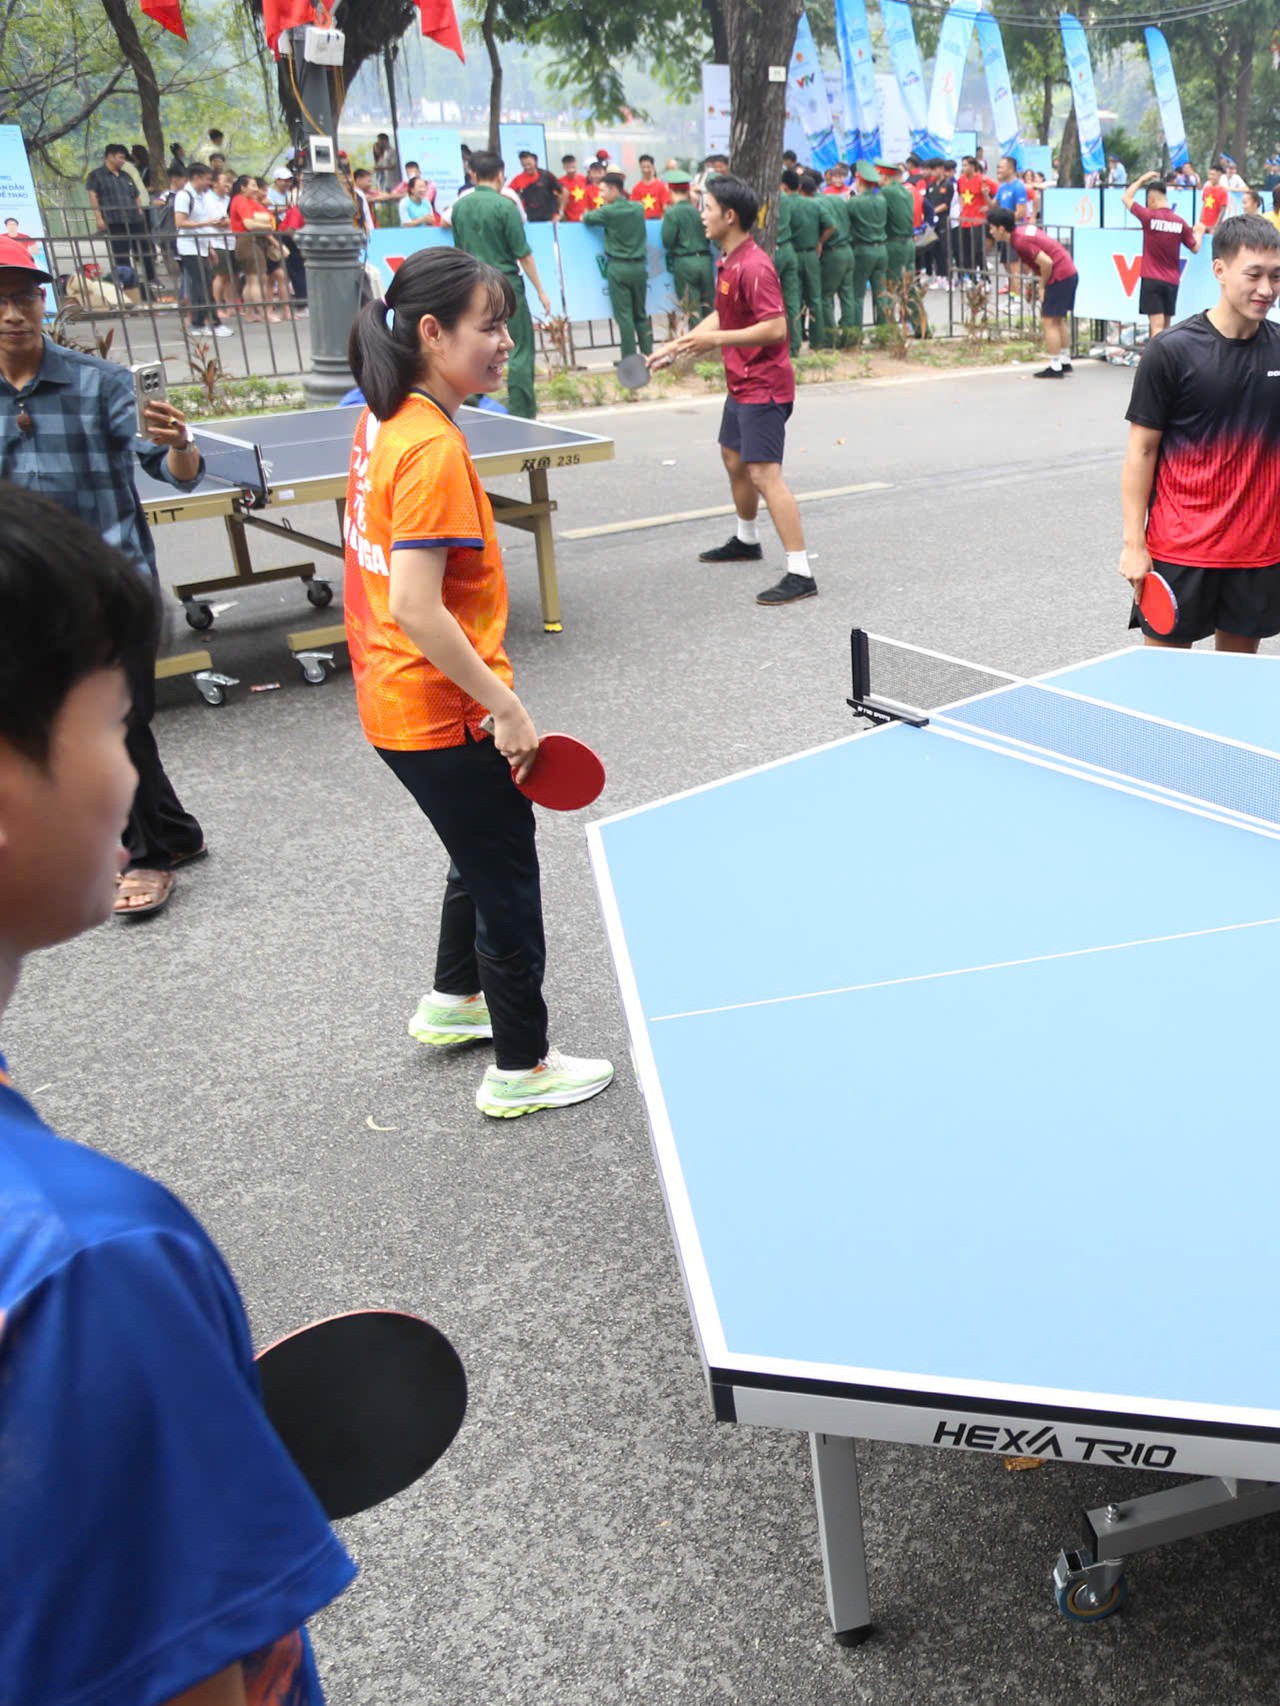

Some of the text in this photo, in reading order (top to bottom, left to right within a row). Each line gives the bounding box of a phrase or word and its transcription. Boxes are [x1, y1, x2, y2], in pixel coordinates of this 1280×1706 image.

[557, 453, 581, 467] 235
[933, 1420, 1177, 1469] HEXA TRIO
